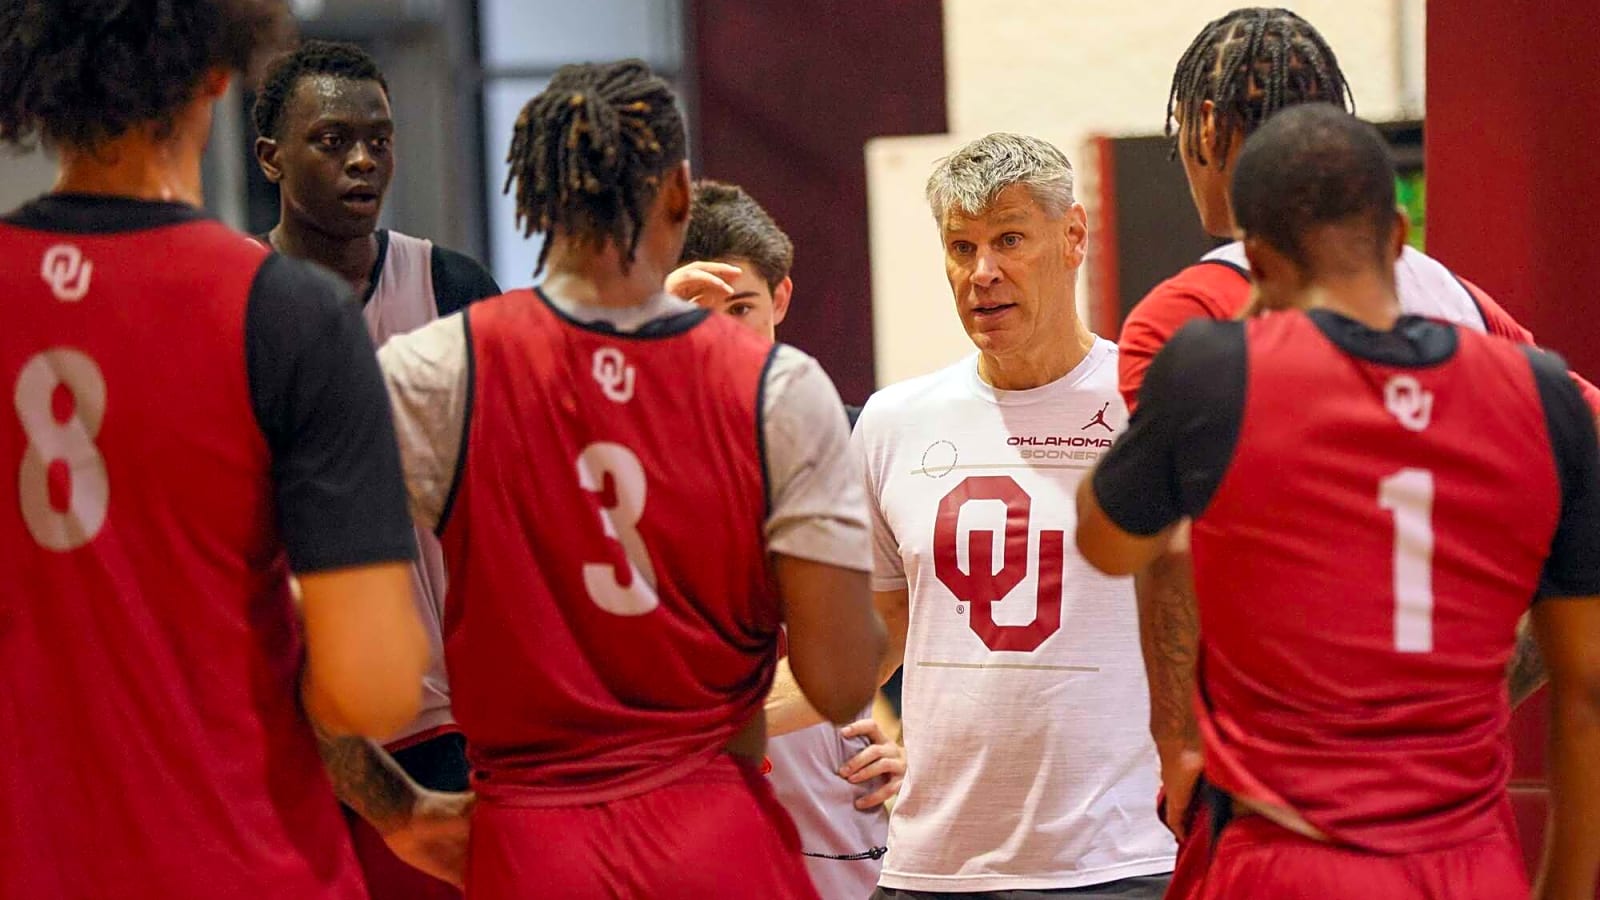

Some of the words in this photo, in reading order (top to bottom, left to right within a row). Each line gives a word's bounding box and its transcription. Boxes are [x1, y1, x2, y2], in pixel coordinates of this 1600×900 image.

[14, 347, 109, 552] 8
[576, 441, 658, 617] 3
[1006, 436, 1113, 448] OKLAHOMA
[1020, 449, 1099, 461] SOONER
[933, 475, 1064, 652] OU
[1378, 468, 1434, 653] 1
